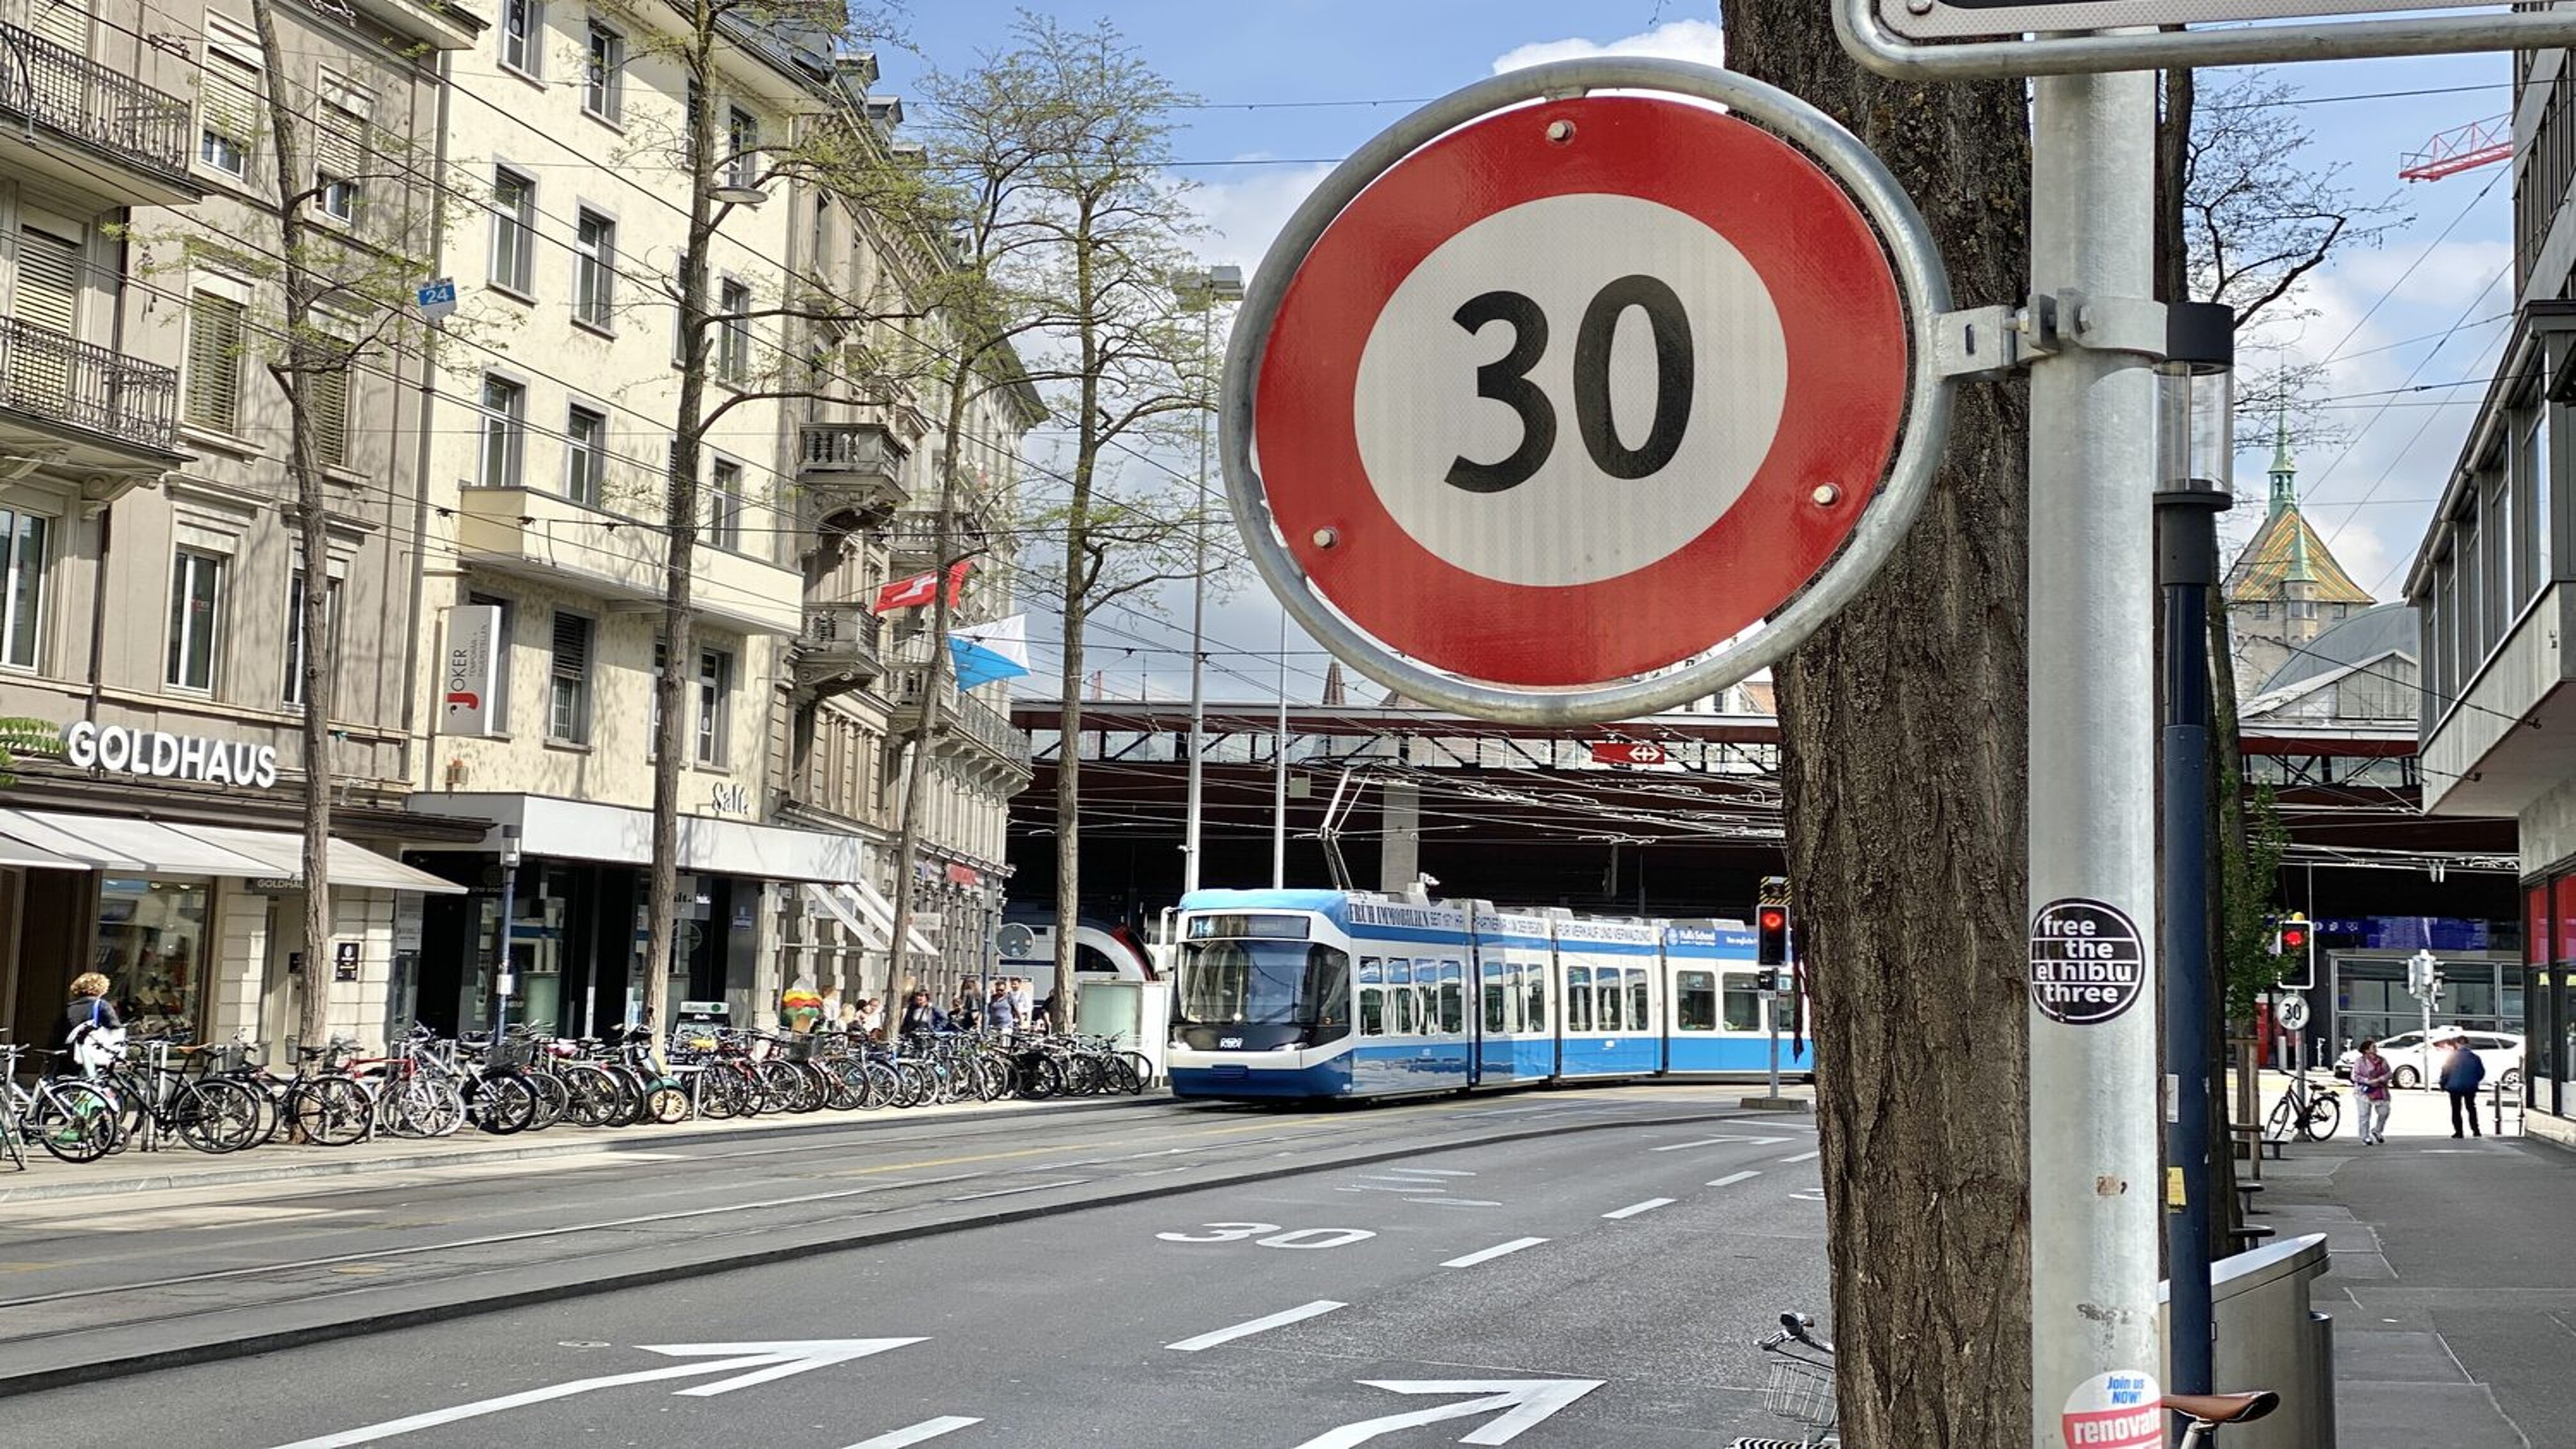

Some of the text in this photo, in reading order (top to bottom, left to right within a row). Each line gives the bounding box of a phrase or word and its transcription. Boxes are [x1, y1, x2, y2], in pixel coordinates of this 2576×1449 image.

[426, 287, 450, 304] 24
[1444, 274, 1695, 493] 30
[447, 649, 478, 710] JOKER
[68, 721, 276, 788] GOLDHAUS
[2043, 915, 2096, 936] free
[2064, 941, 2114, 959] the
[2036, 962, 2055, 980] el
[2044, 984, 2119, 1003] three
[2284, 1003, 2302, 1021] 30
[1154, 1222, 1377, 1248] 30
[2107, 1376, 2145, 1390] Join us
[2112, 1391, 2142, 1404] NOW!
